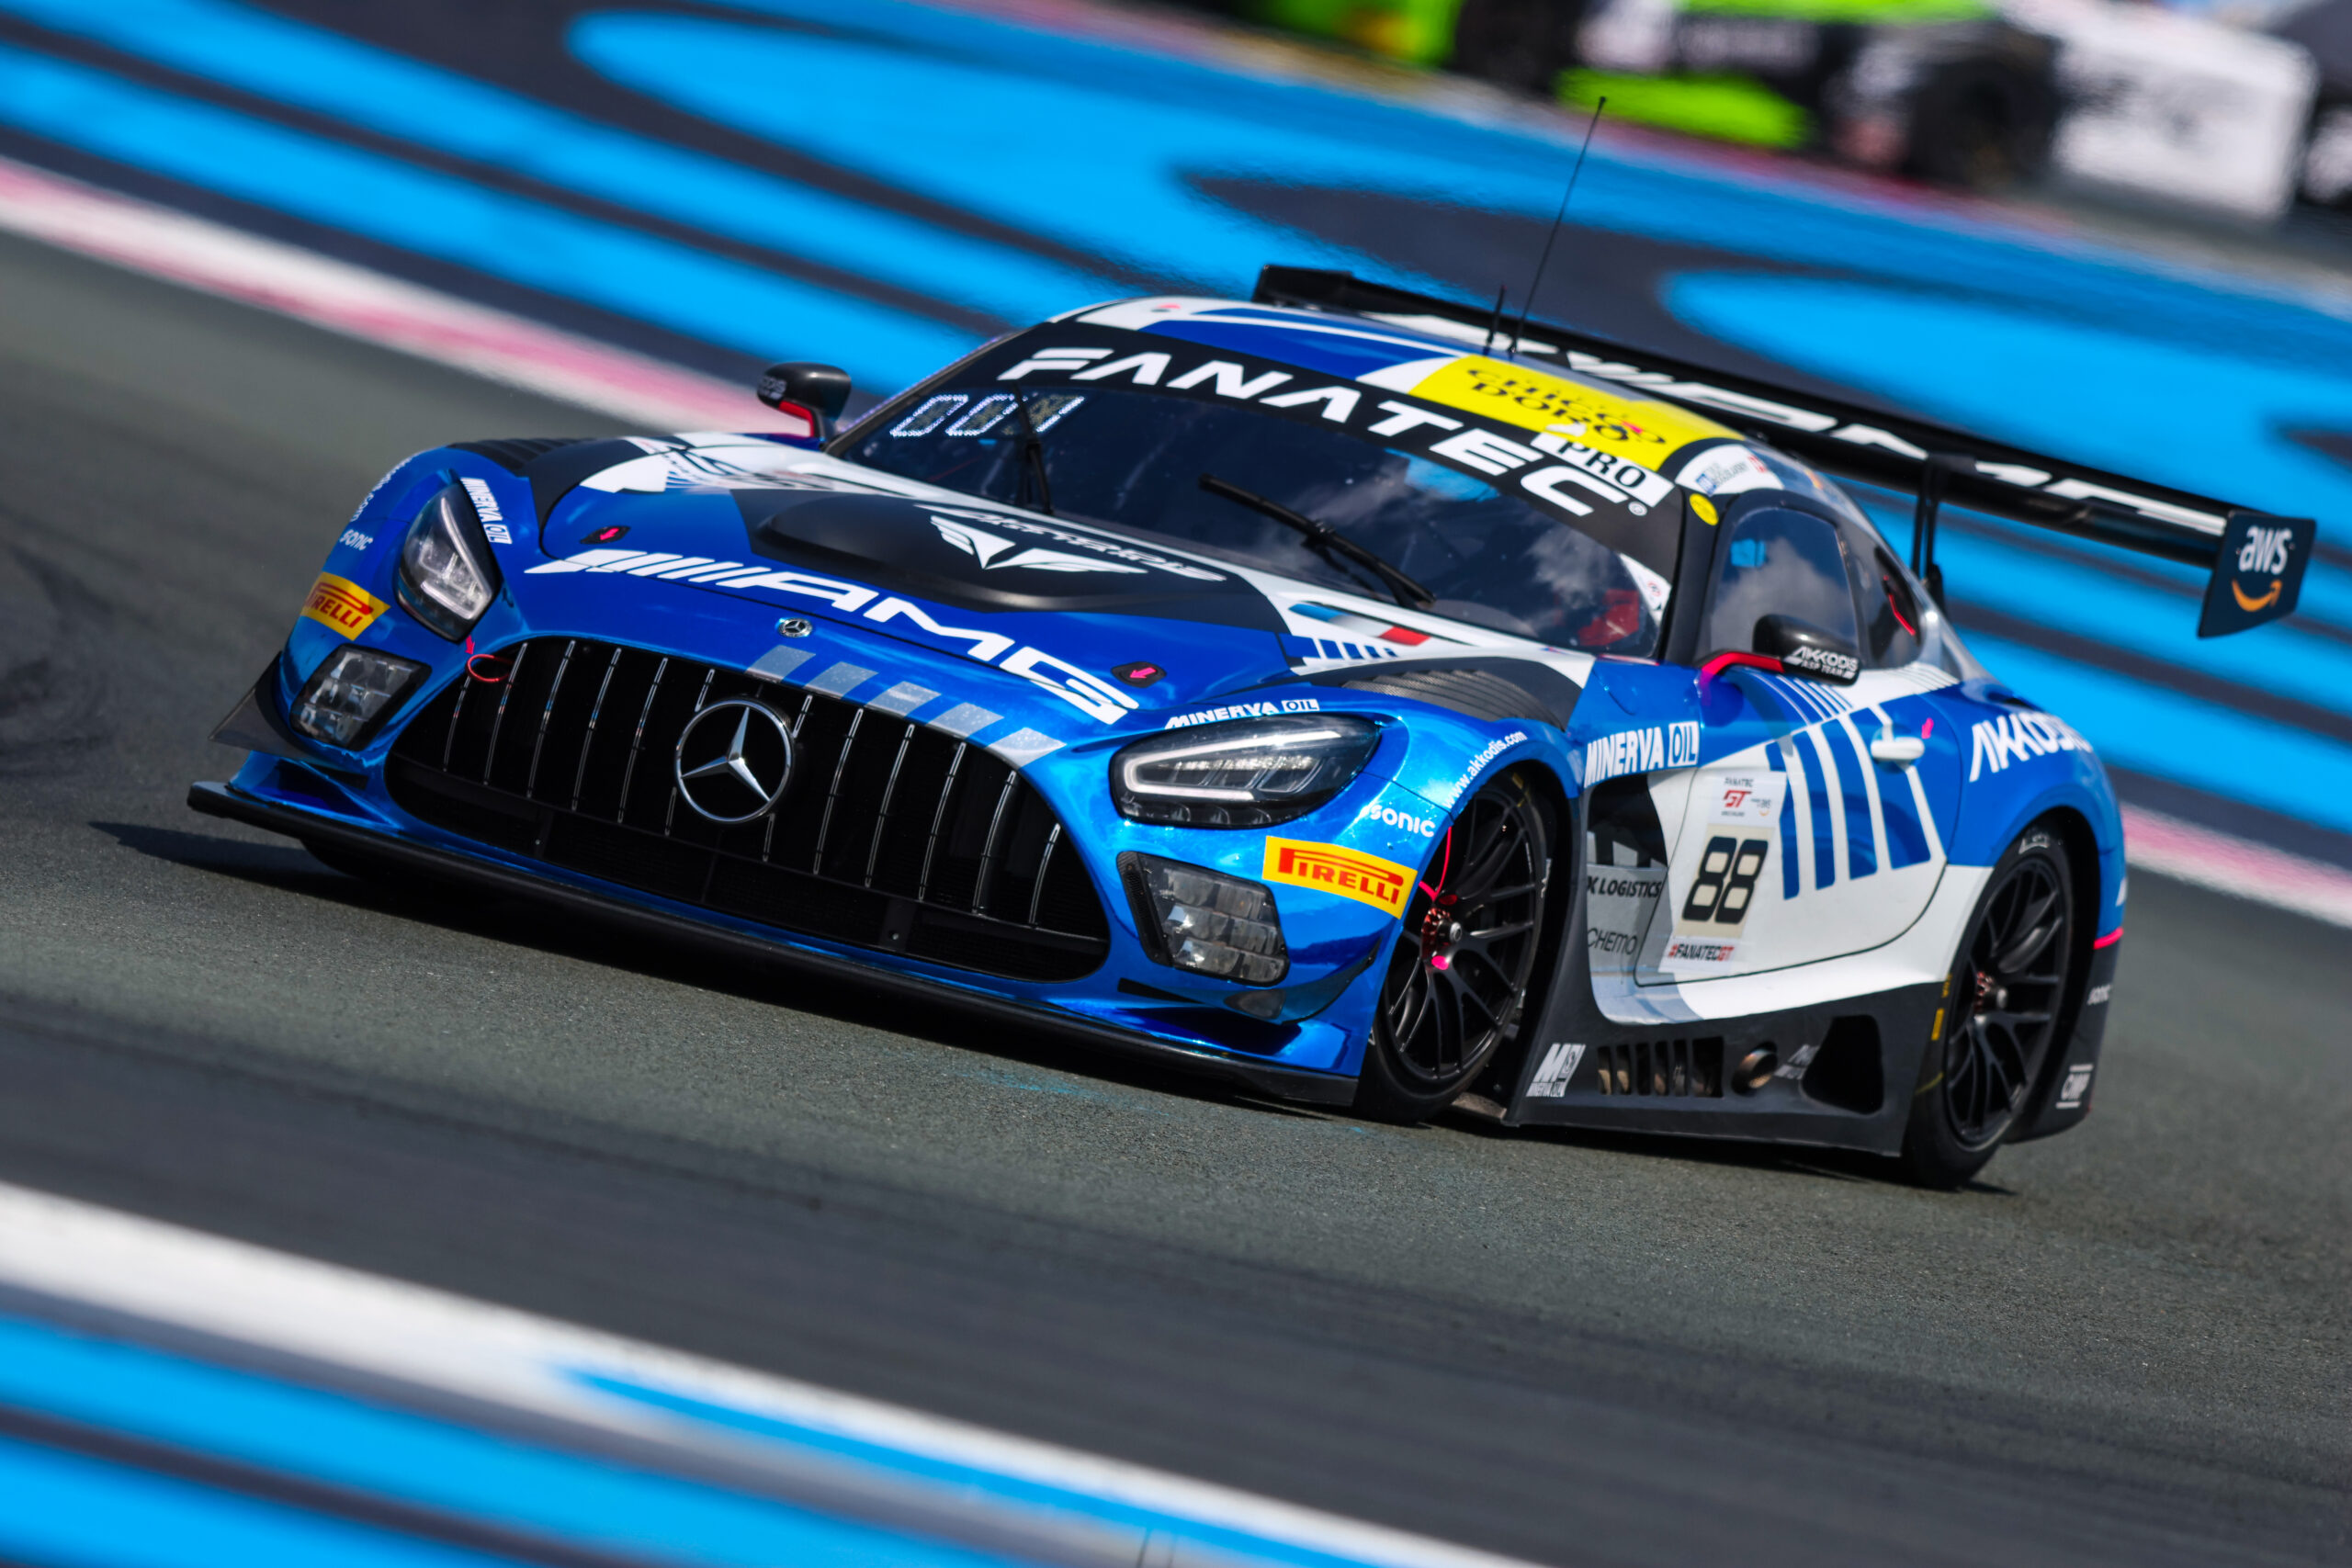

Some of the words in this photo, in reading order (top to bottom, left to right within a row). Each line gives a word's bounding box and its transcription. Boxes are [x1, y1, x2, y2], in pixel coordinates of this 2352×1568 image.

[998, 349, 1629, 516] FANATEC
[1558, 439, 1646, 488] PRO
[484, 525, 511, 542] OIL
[2238, 525, 2293, 575] aws
[717, 570, 1141, 726] AMG
[1164, 701, 1280, 730] MINERVA
[1283, 699, 1320, 712] OIL
[1442, 730, 1528, 809] www.akkodis.com
[1583, 726, 1665, 789] MINERVA
[1669, 722, 1699, 767] OIL
[1277, 847, 1405, 905] PIRELLI
[1598, 877, 1663, 899] LOGISTICS
[1681, 835, 1769, 925] 88
